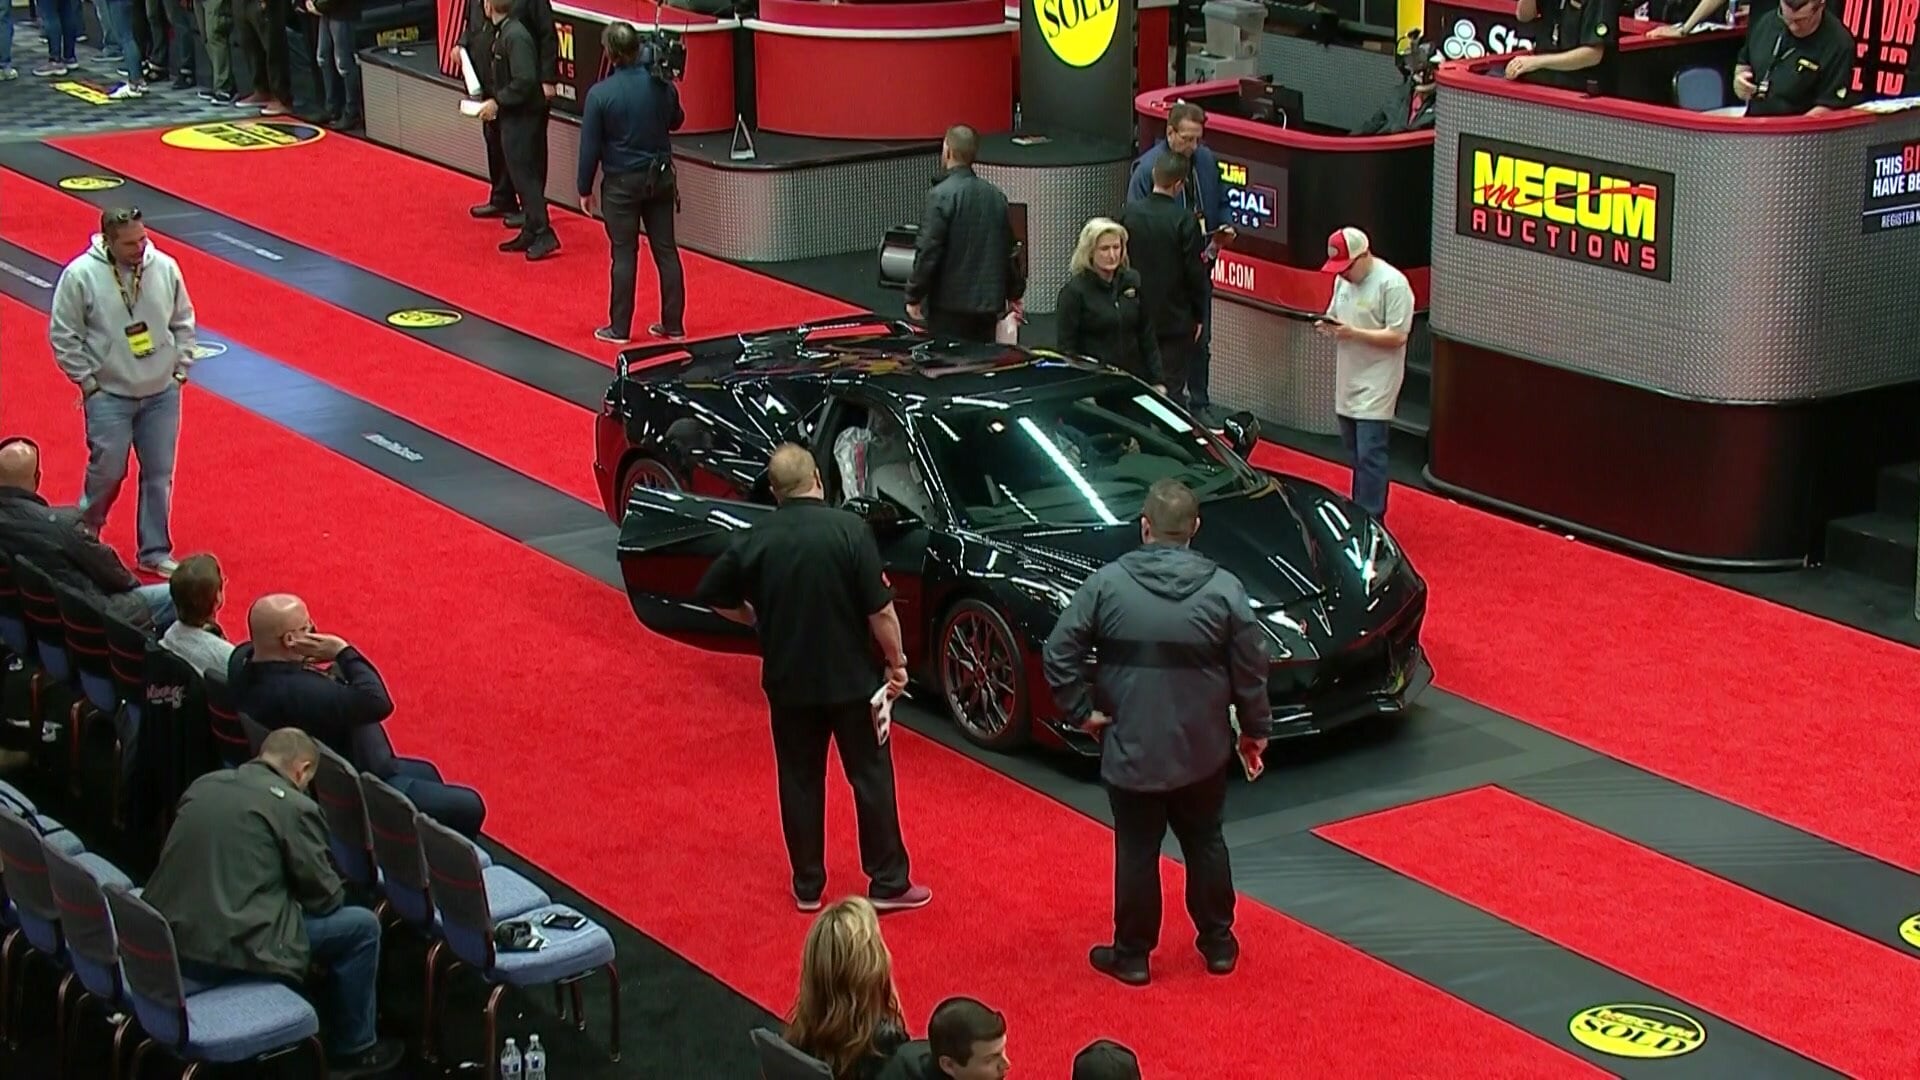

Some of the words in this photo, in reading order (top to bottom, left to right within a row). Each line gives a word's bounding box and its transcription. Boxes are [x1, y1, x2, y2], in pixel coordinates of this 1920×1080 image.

[1043, 0, 1116, 38] SOL
[1874, 155, 1903, 178] THIS
[1904, 145, 1920, 172] BI
[1227, 187, 1272, 216] CIAL
[1473, 149, 1658, 243] MECUM
[1872, 175, 1906, 198] HAVE
[1907, 172, 1920, 193] BE
[1472, 208, 1657, 271] AUCTIONS
[1211, 258, 1255, 292] M.COM
[1575, 1018, 1688, 1052] SOLD
